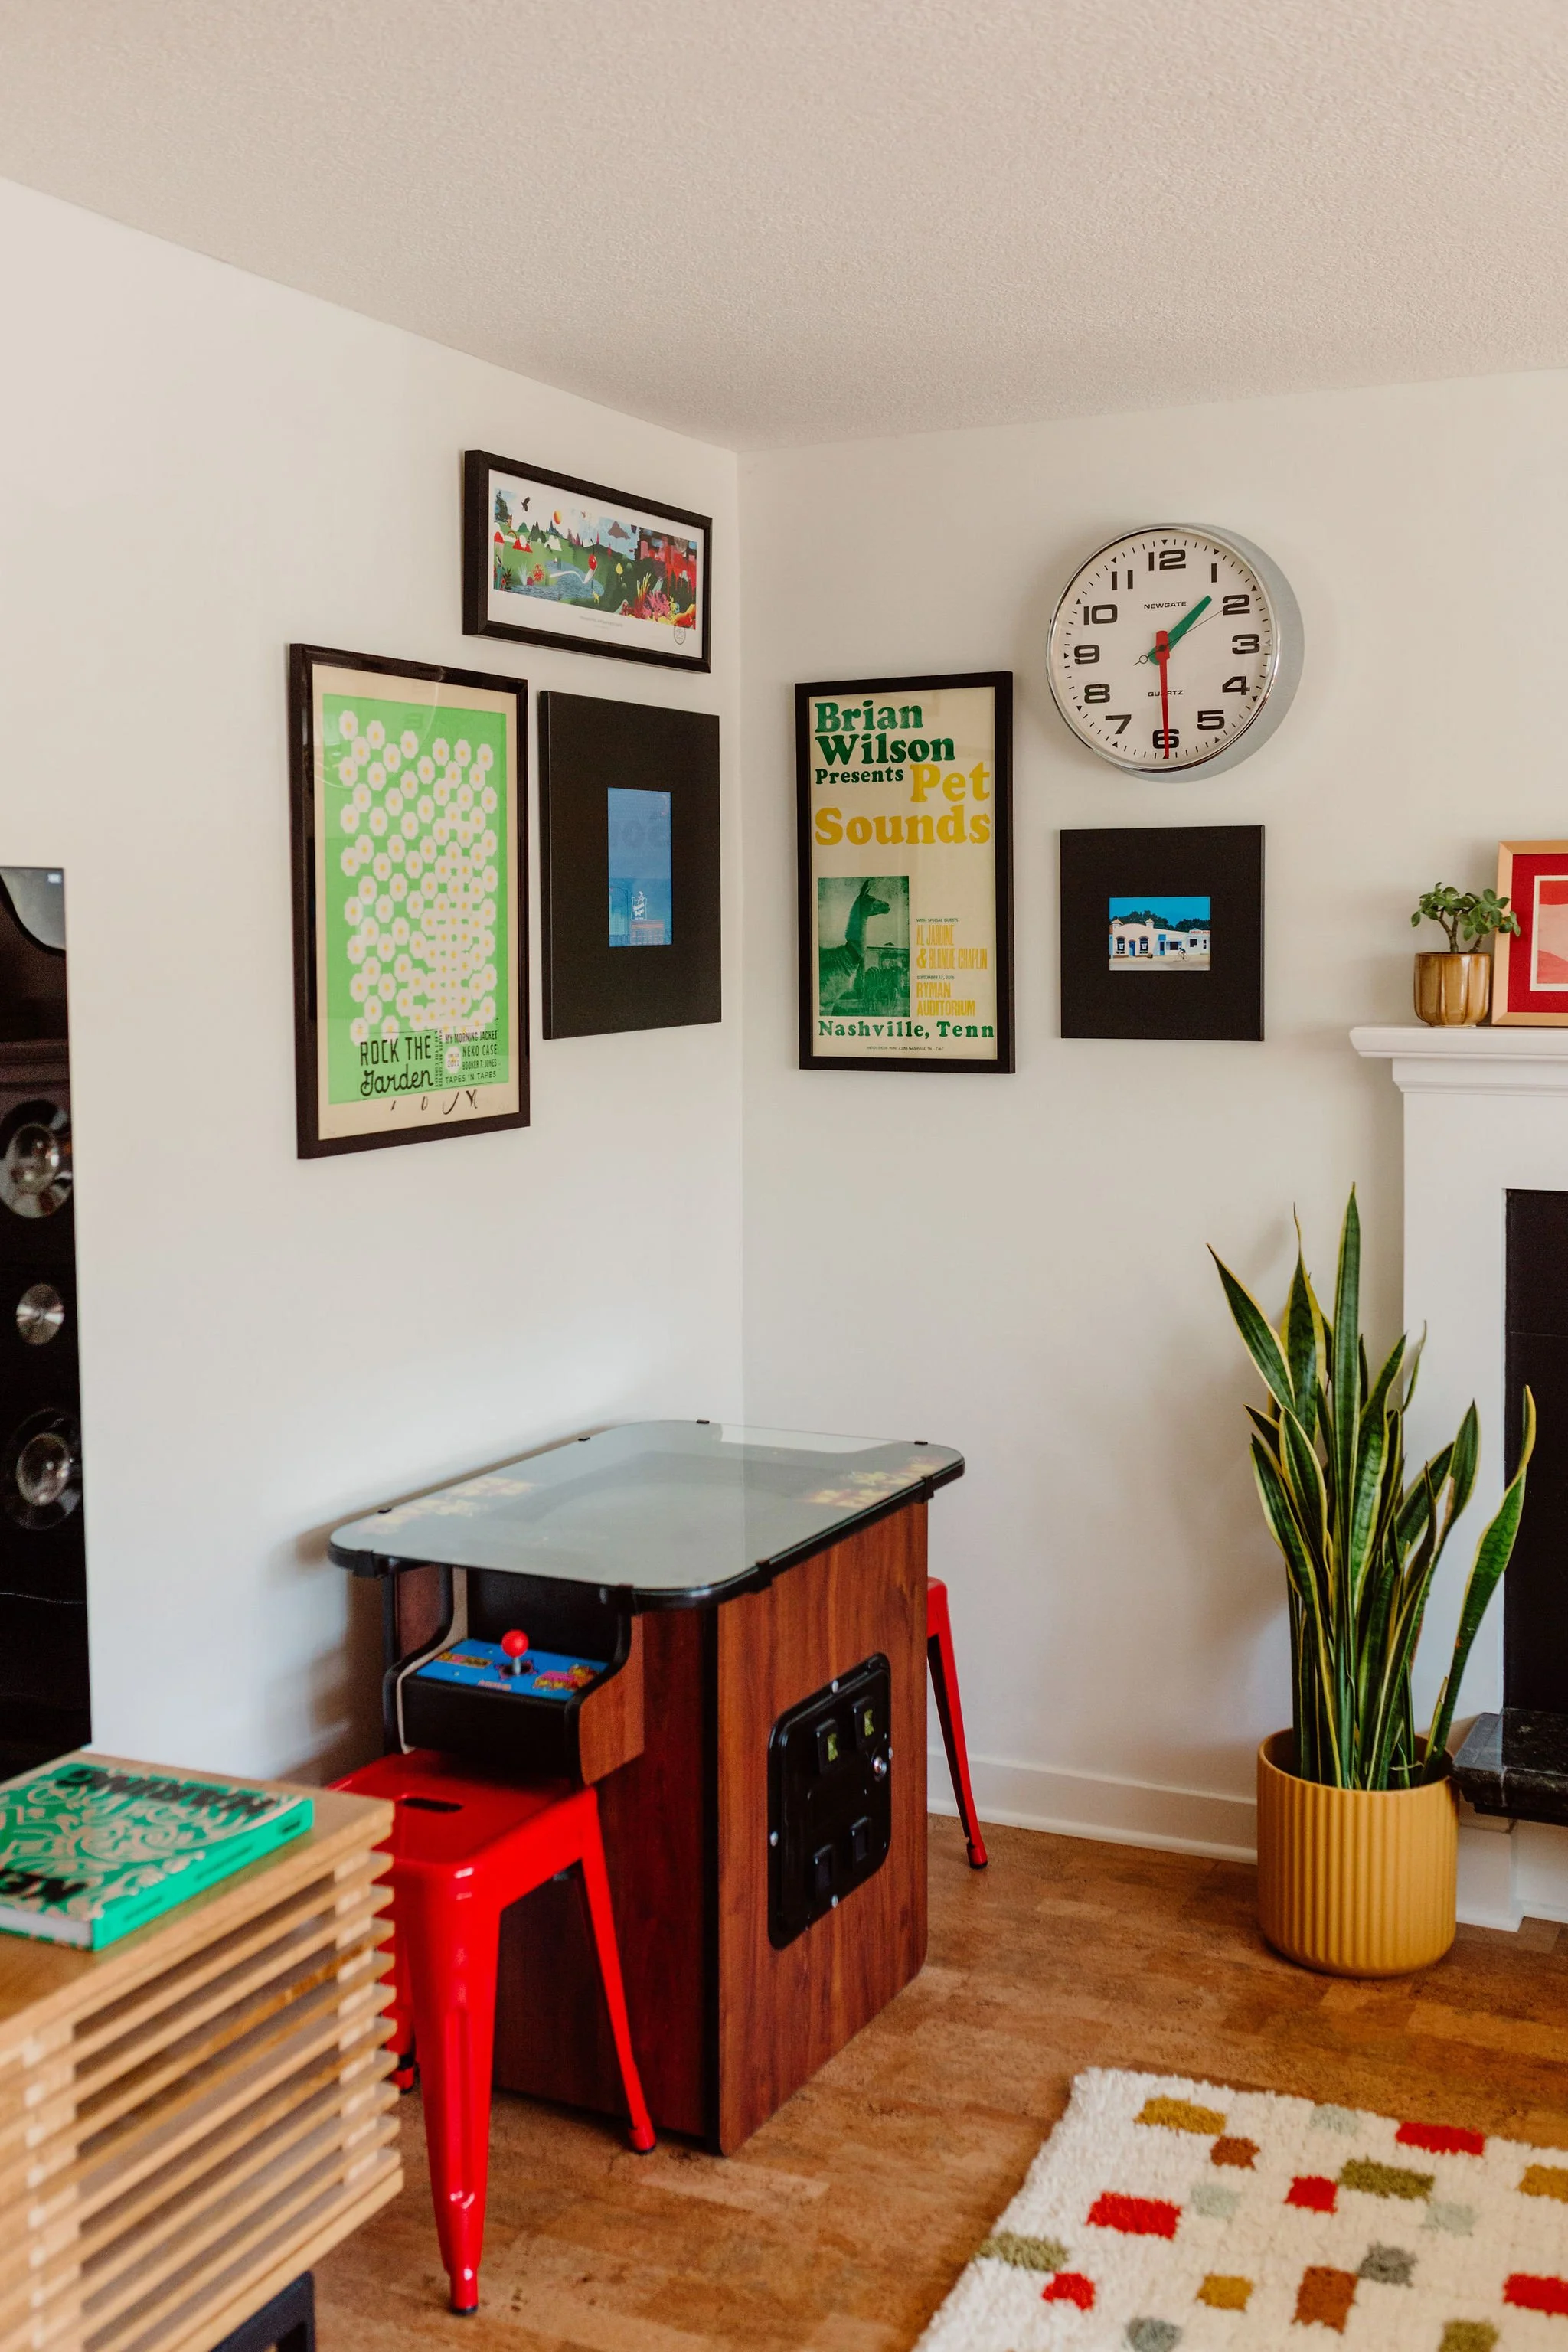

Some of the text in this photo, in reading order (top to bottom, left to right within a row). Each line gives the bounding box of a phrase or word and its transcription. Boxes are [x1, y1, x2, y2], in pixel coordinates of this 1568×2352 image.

[1148, 549, 1187, 571] 12
[1112, 570, 1133, 590] 11
[1211, 563, 1217, 583] 1
[1083, 603, 1118, 626] 10
[1144, 601, 1187, 609] NEWGATE
[1222, 593, 1250, 616] 2
[1073, 644, 1100, 665] 9
[1231, 633, 1260, 655] 3
[1084, 683, 1110, 704] 8
[1221, 675, 1251, 696] 4
[815, 700, 923, 733] Brian
[1105, 714, 1132, 735] 7
[1197, 709, 1225, 730] 5
[1152, 728, 1180, 749] 6
[815, 733, 956, 766] Wilson
[815, 766, 904, 785] Presents
[910, 762, 990, 802] Pet
[815, 805, 991, 846] Sounds
[916, 948, 927, 969] &
[916, 982, 951, 998] RYMAN
[916, 1000, 975, 1017] AUDITORIUM
[445, 1030, 498, 1044] MY MORNING JACKET
[818, 1020, 995, 1040] Nashville, Tenn
[361, 1035, 431, 1066] ROCK THE
[462, 1045, 479, 1057] NEKO
[482, 1044, 497, 1056] CASE
[361, 1063, 434, 1096] Garden
[445, 1074, 466, 1084] TAPES
[477, 1071, 497, 1080] TAPES
